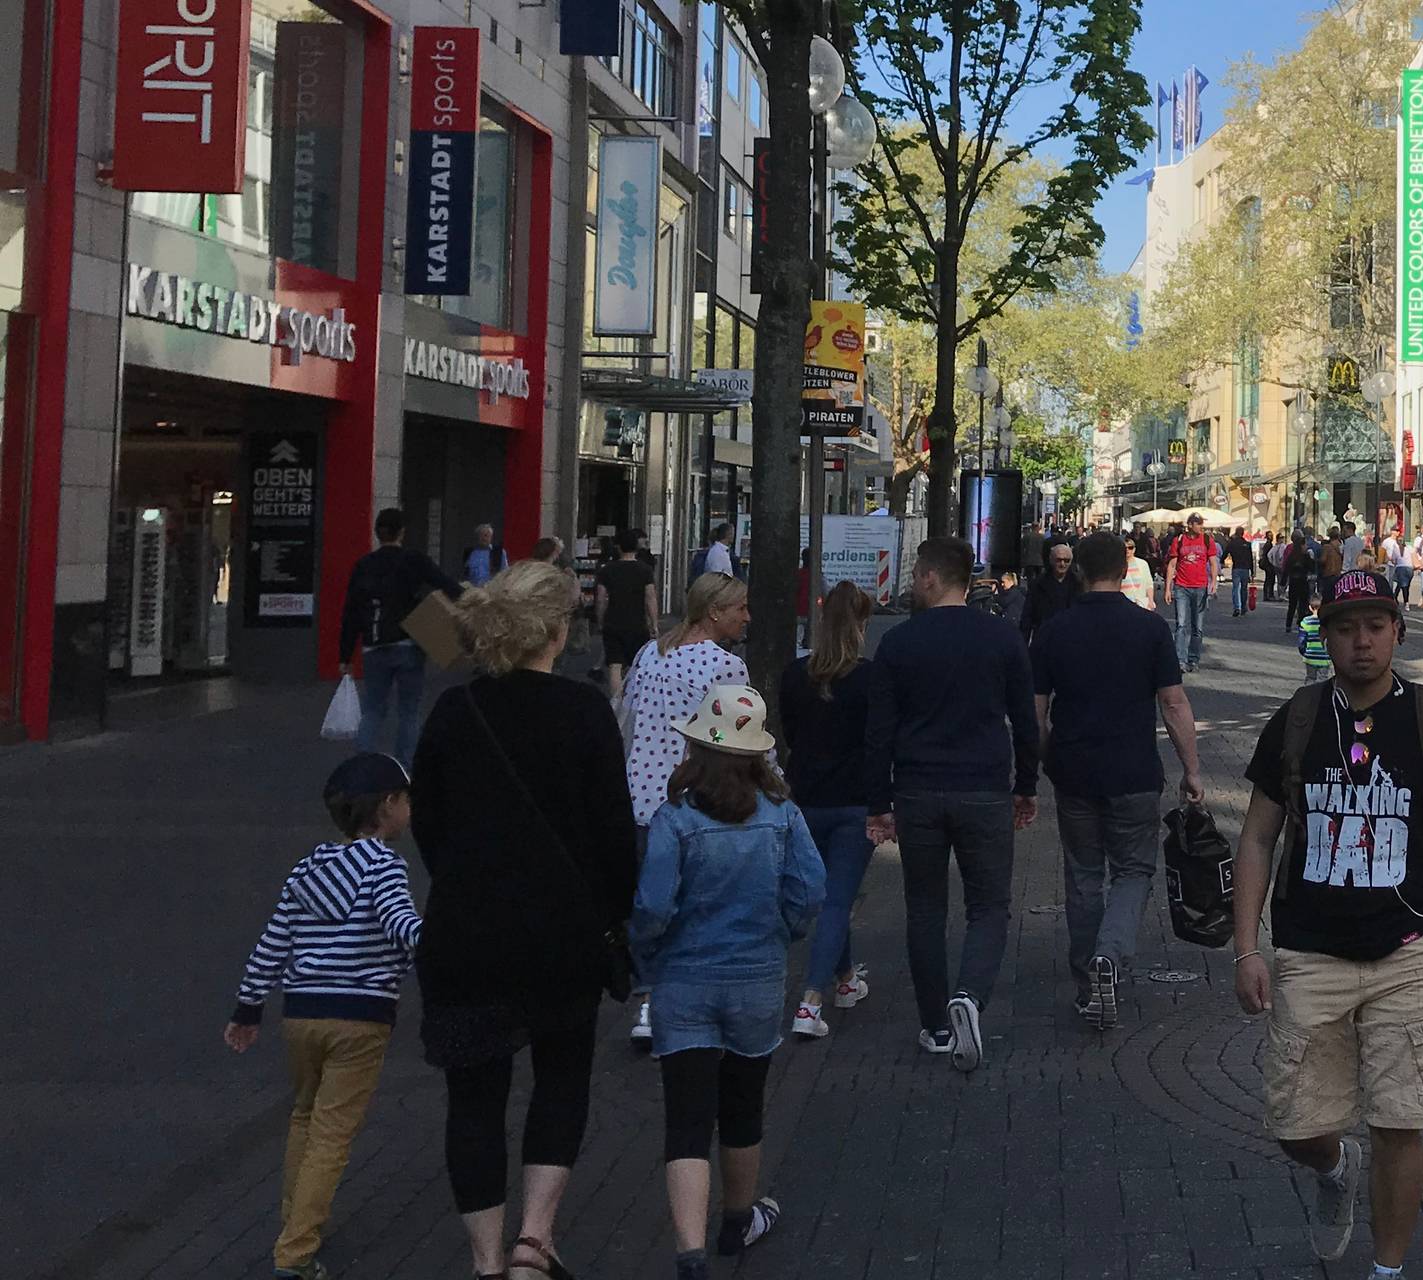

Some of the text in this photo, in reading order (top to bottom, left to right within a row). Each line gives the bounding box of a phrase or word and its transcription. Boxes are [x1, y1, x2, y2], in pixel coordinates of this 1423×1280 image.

[427, 39, 460, 282] KARSTADT sports
[606, 181, 647, 291] Douglas
[128, 263, 356, 367] KARSTADT sports
[1408, 287, 1423, 356] UNITED
[404, 336, 530, 404] KARSTADT sports
[809, 411, 854, 423] PIRATEN
[252, 487, 313, 502] GEHT'S
[253, 468, 313, 486] OBEN
[252, 502, 312, 516] WEITER!
[1334, 573, 1377, 600] BULLS
[1324, 767, 1343, 783] THE
[1304, 783, 1412, 818] WALKING
[1303, 812, 1409, 888] DAD
